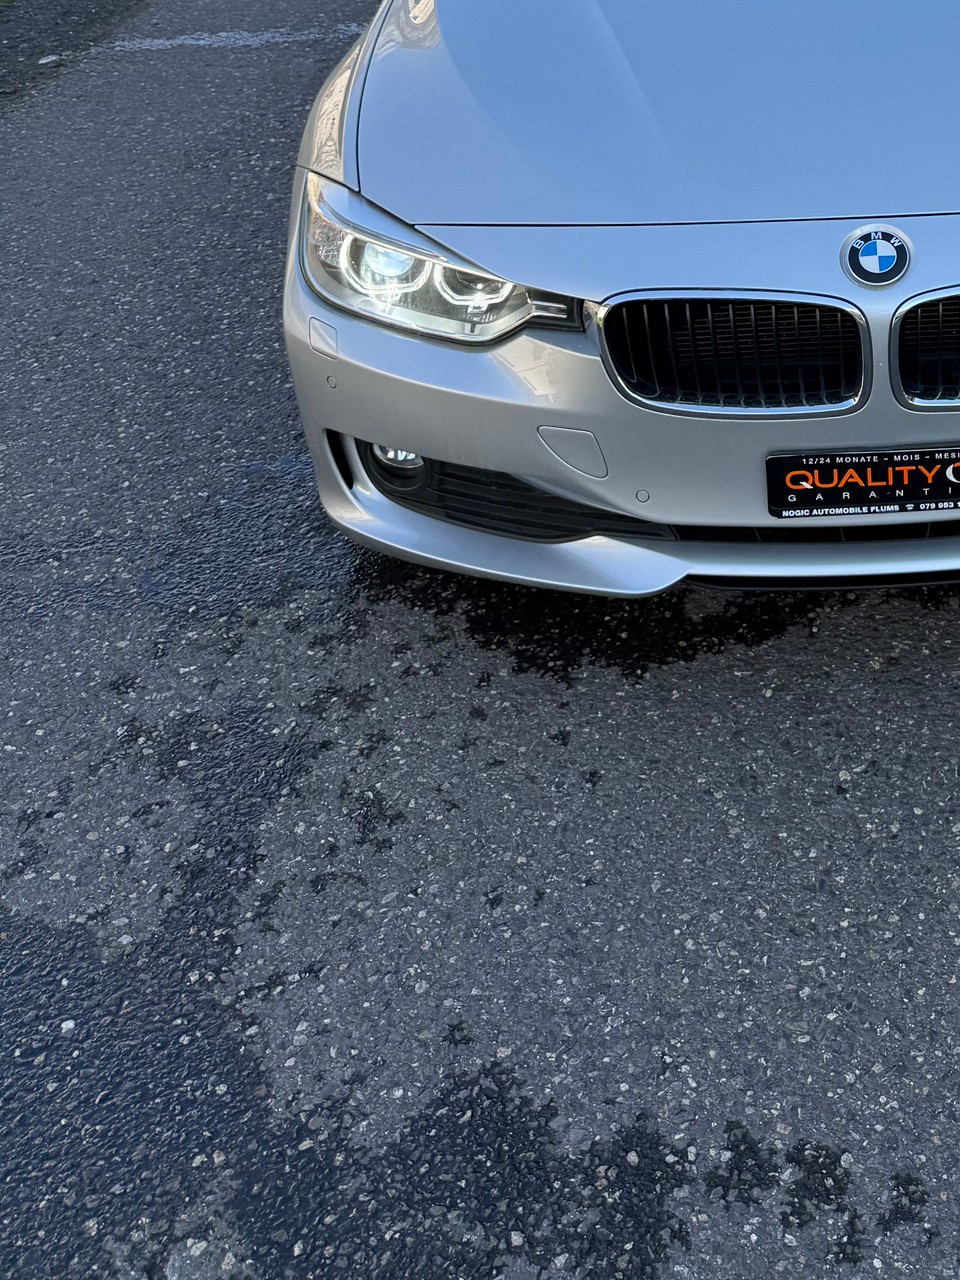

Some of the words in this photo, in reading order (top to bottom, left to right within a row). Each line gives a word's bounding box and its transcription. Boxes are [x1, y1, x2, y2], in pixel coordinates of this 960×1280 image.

[853, 231, 903, 250] BMW
[801, 457, 831, 465] 12/24
[835, 455, 879, 463] MONATE
[935, 452, 960, 460] MESI
[785, 464, 942, 490] QUALITY
[782, 509, 810, 518] NOGIC
[811, 506, 868, 516] AUTOMOBILE
[870, 505, 900, 513] FLUMS
